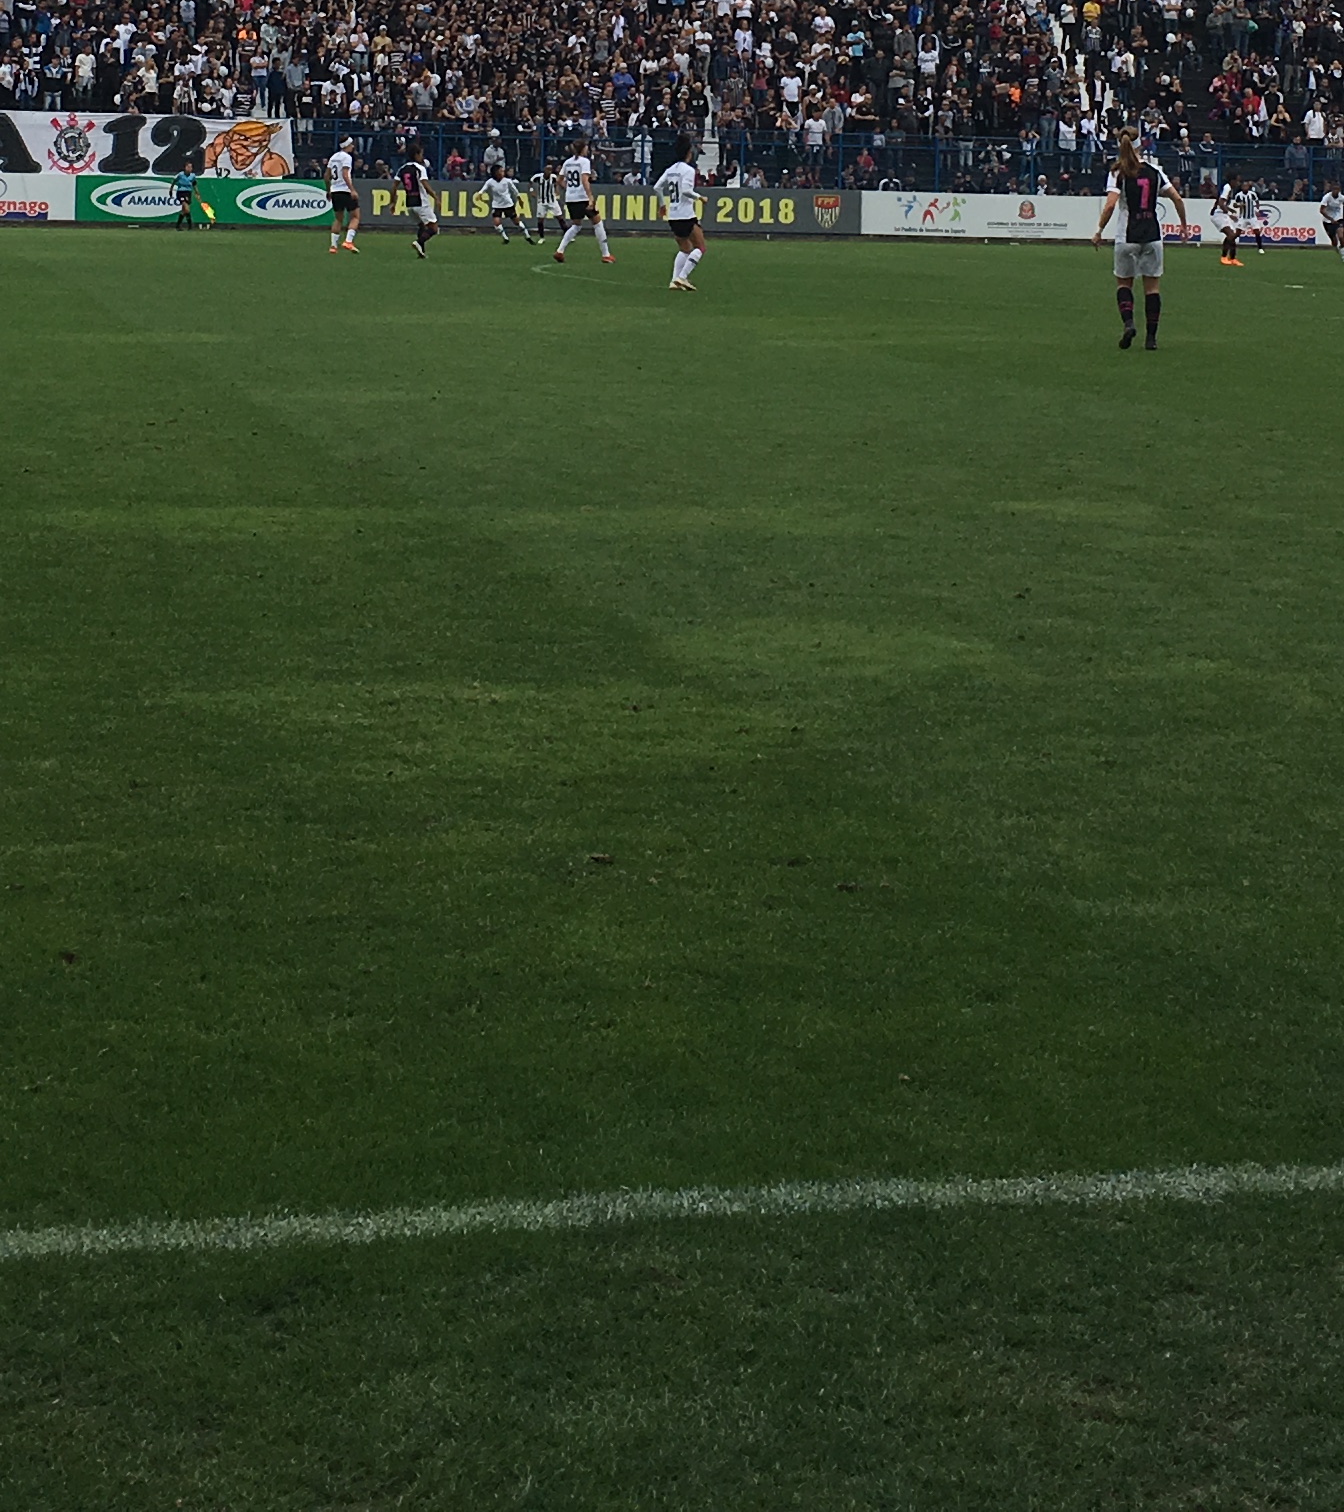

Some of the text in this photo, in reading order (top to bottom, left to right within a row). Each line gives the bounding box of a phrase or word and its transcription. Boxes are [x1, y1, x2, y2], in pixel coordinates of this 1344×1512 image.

[98, 115, 207, 175] 12
[331, 165, 339, 180] 3
[567, 170, 581, 188] 99
[402, 173, 413, 191] 5
[272, 199, 327, 209] AMANCO
[371, 189, 533, 218] PALISA
[716, 197, 795, 224] 2018
